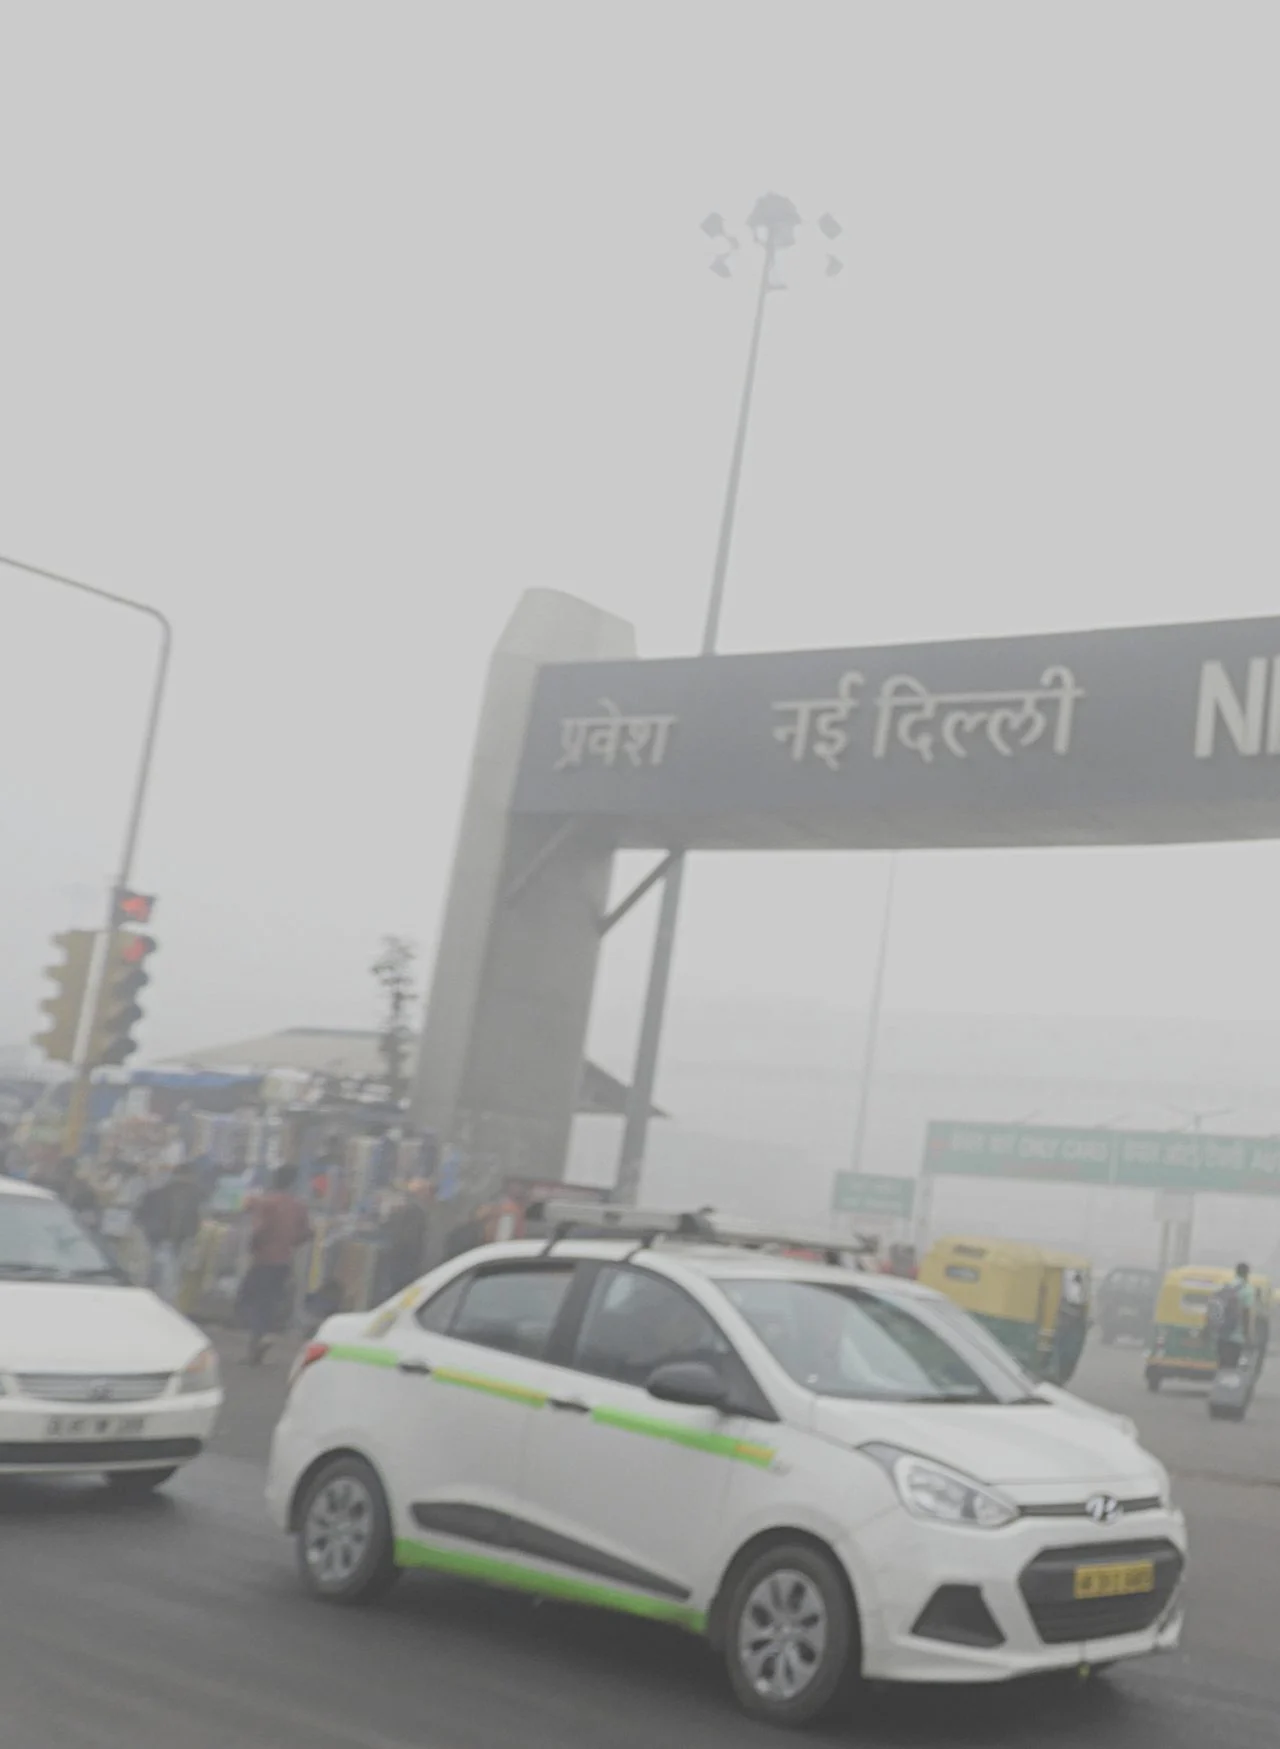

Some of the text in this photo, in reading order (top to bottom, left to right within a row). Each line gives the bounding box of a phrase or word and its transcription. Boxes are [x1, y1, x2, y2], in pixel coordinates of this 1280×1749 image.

[554, 699, 677, 770] प्रवेश
[772, 666, 1084, 769] नई दिल्ली
